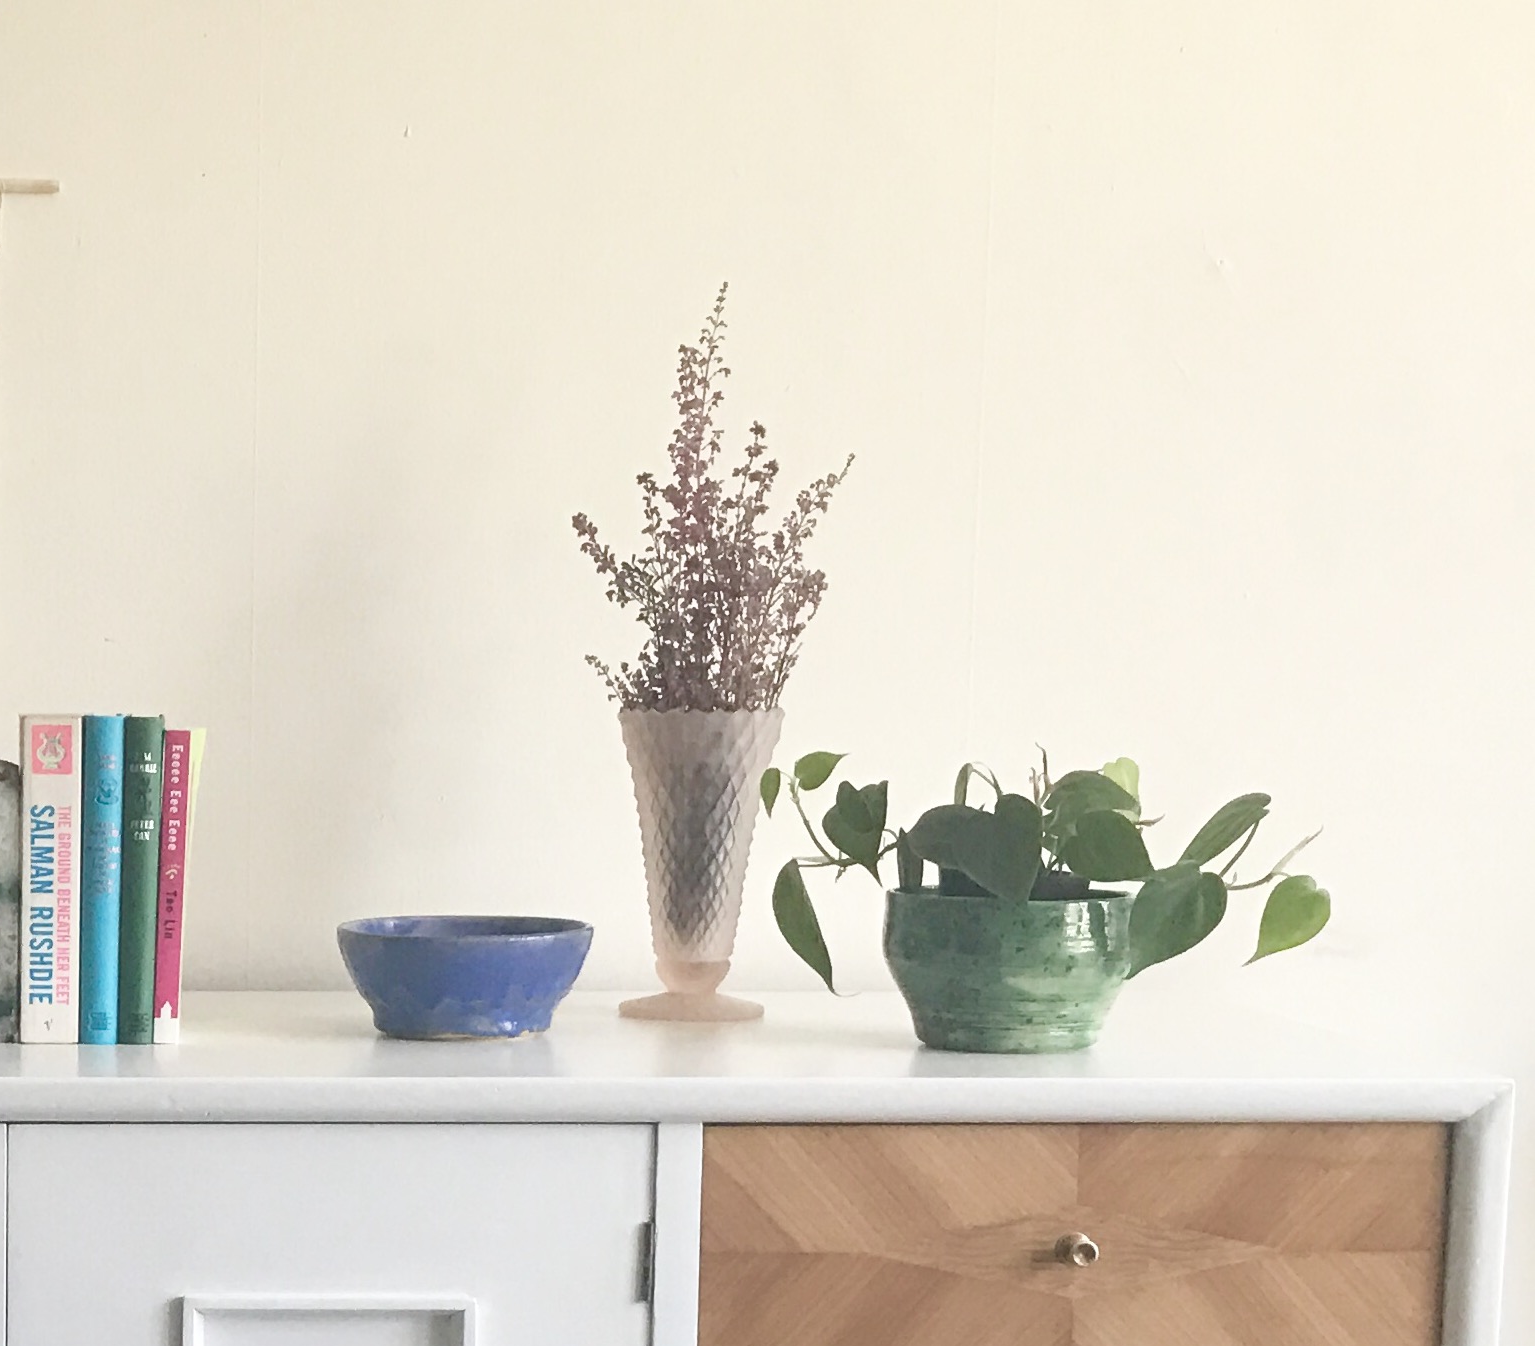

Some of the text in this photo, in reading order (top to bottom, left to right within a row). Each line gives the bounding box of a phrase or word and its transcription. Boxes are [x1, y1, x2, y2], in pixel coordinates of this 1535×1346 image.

[167, 819, 181, 851] Eeee
[169, 790, 182, 814] Eee
[29, 804, 55, 1005] SALMAN RUSHDIE
[56, 806, 72, 1005] THE GROUND BENEATH HER FEET
